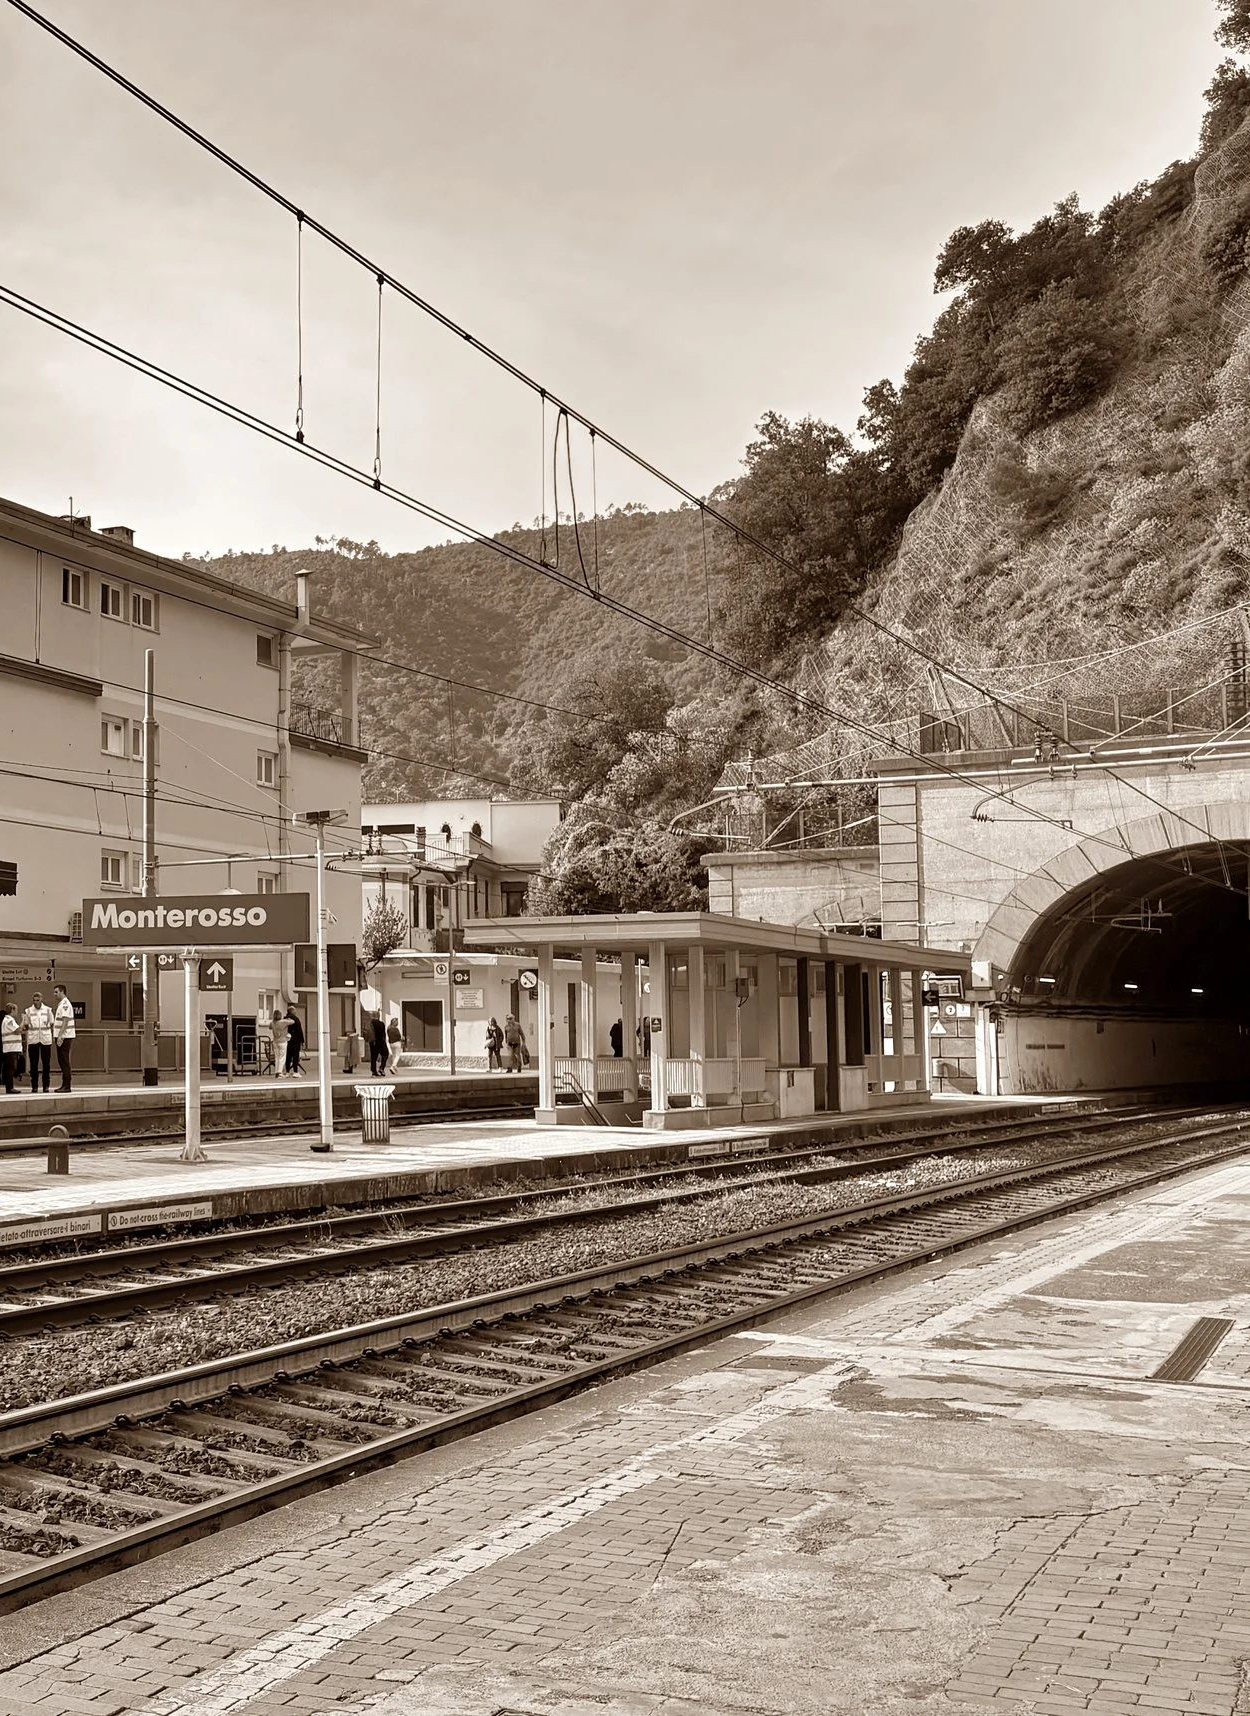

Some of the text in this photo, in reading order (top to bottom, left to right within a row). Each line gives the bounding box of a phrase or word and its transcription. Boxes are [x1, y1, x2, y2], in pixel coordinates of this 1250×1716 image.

[91, 903, 267, 929] Monterosso
[119, 1215, 128, 1225] Do
[141, 1213, 158, 1222] cross
[168, 1208, 193, 1219] railway
[193, 1206, 205, 1216] lines
[19, 1226, 64, 1239] attraversare
[70, 1220, 91, 1231] binari
